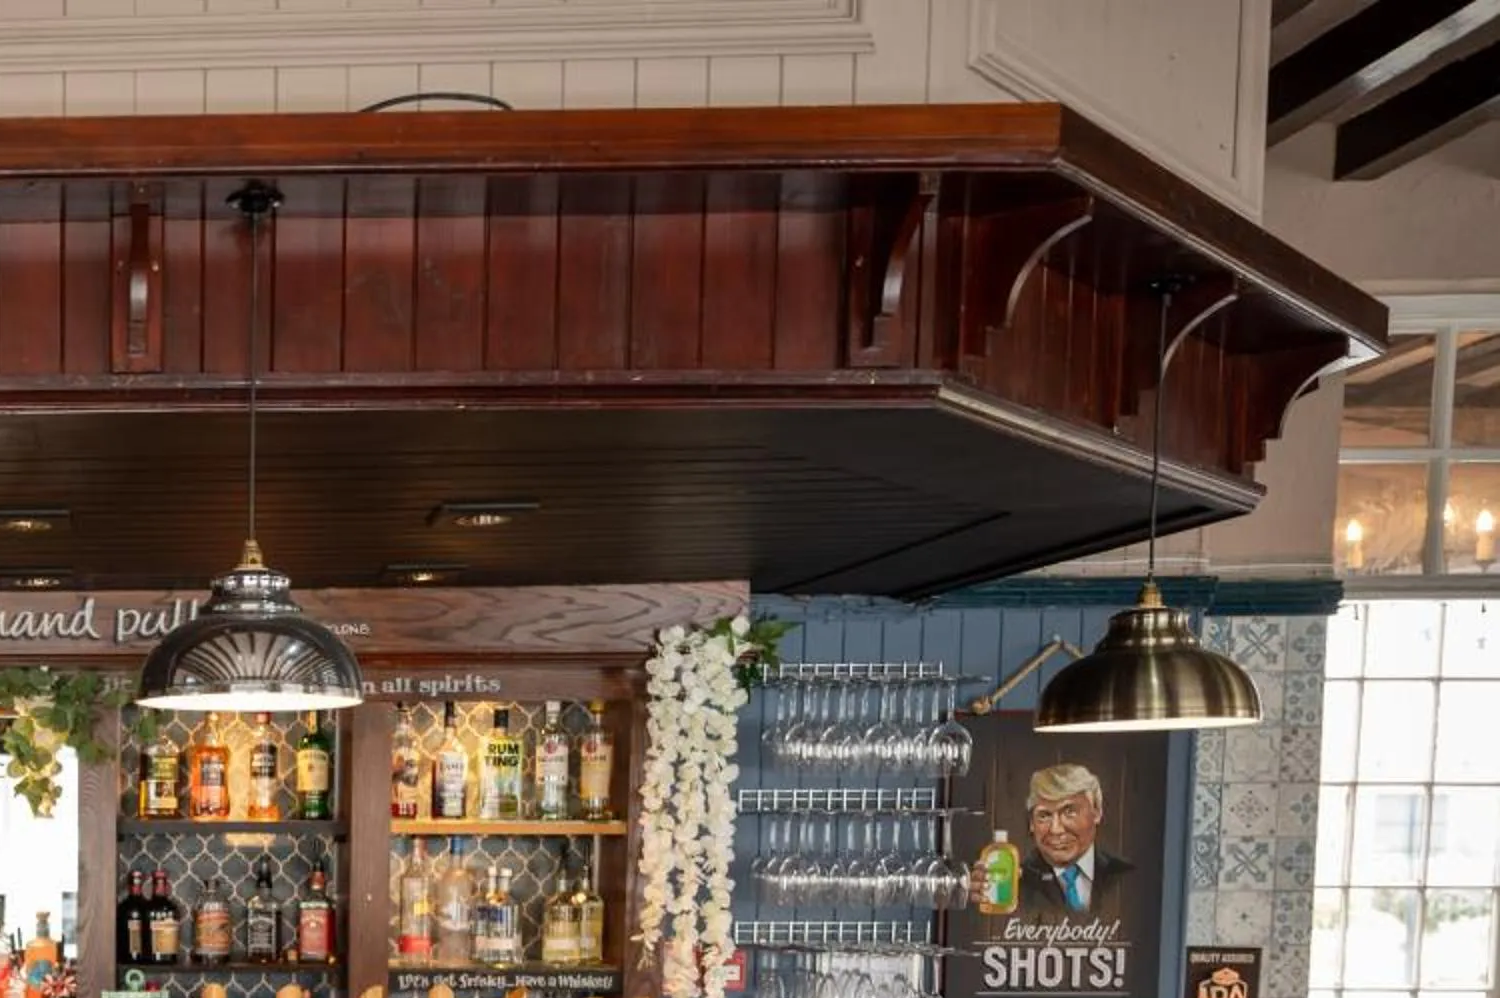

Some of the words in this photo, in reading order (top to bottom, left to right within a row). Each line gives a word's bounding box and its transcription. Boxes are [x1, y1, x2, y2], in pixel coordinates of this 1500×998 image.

[116, 597, 199, 643] pull
[381, 677, 411, 692] all
[419, 673, 500, 697] spirits
[488, 743, 519, 754] RUM
[484, 756, 519, 767] TING
[1003, 918, 1121, 943] Everybody!
[983, 946, 1127, 989] SHOTS!
